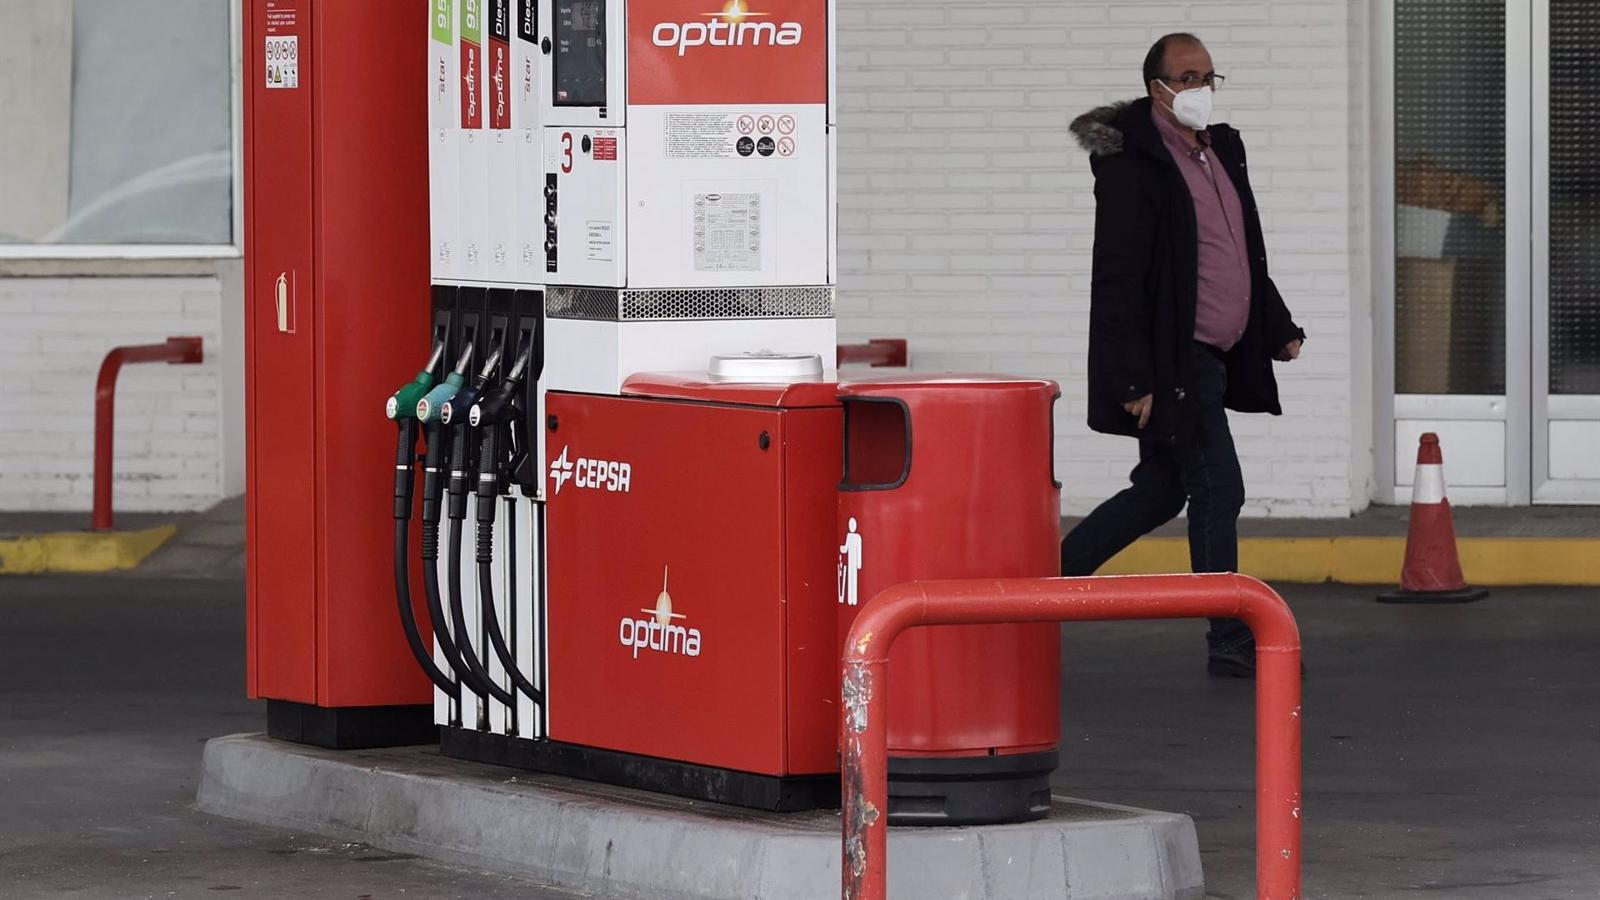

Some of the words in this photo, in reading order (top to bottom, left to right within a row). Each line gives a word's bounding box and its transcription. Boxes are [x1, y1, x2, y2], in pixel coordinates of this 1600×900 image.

[437, 0, 447, 29] 95
[466, 0, 476, 29] 95
[652, 18, 803, 57] optima
[468, 48, 476, 117] optima
[497, 47, 505, 117] optima
[561, 131, 573, 174] 3
[575, 457, 631, 493] CEPSA
[619, 616, 701, 659] optima
